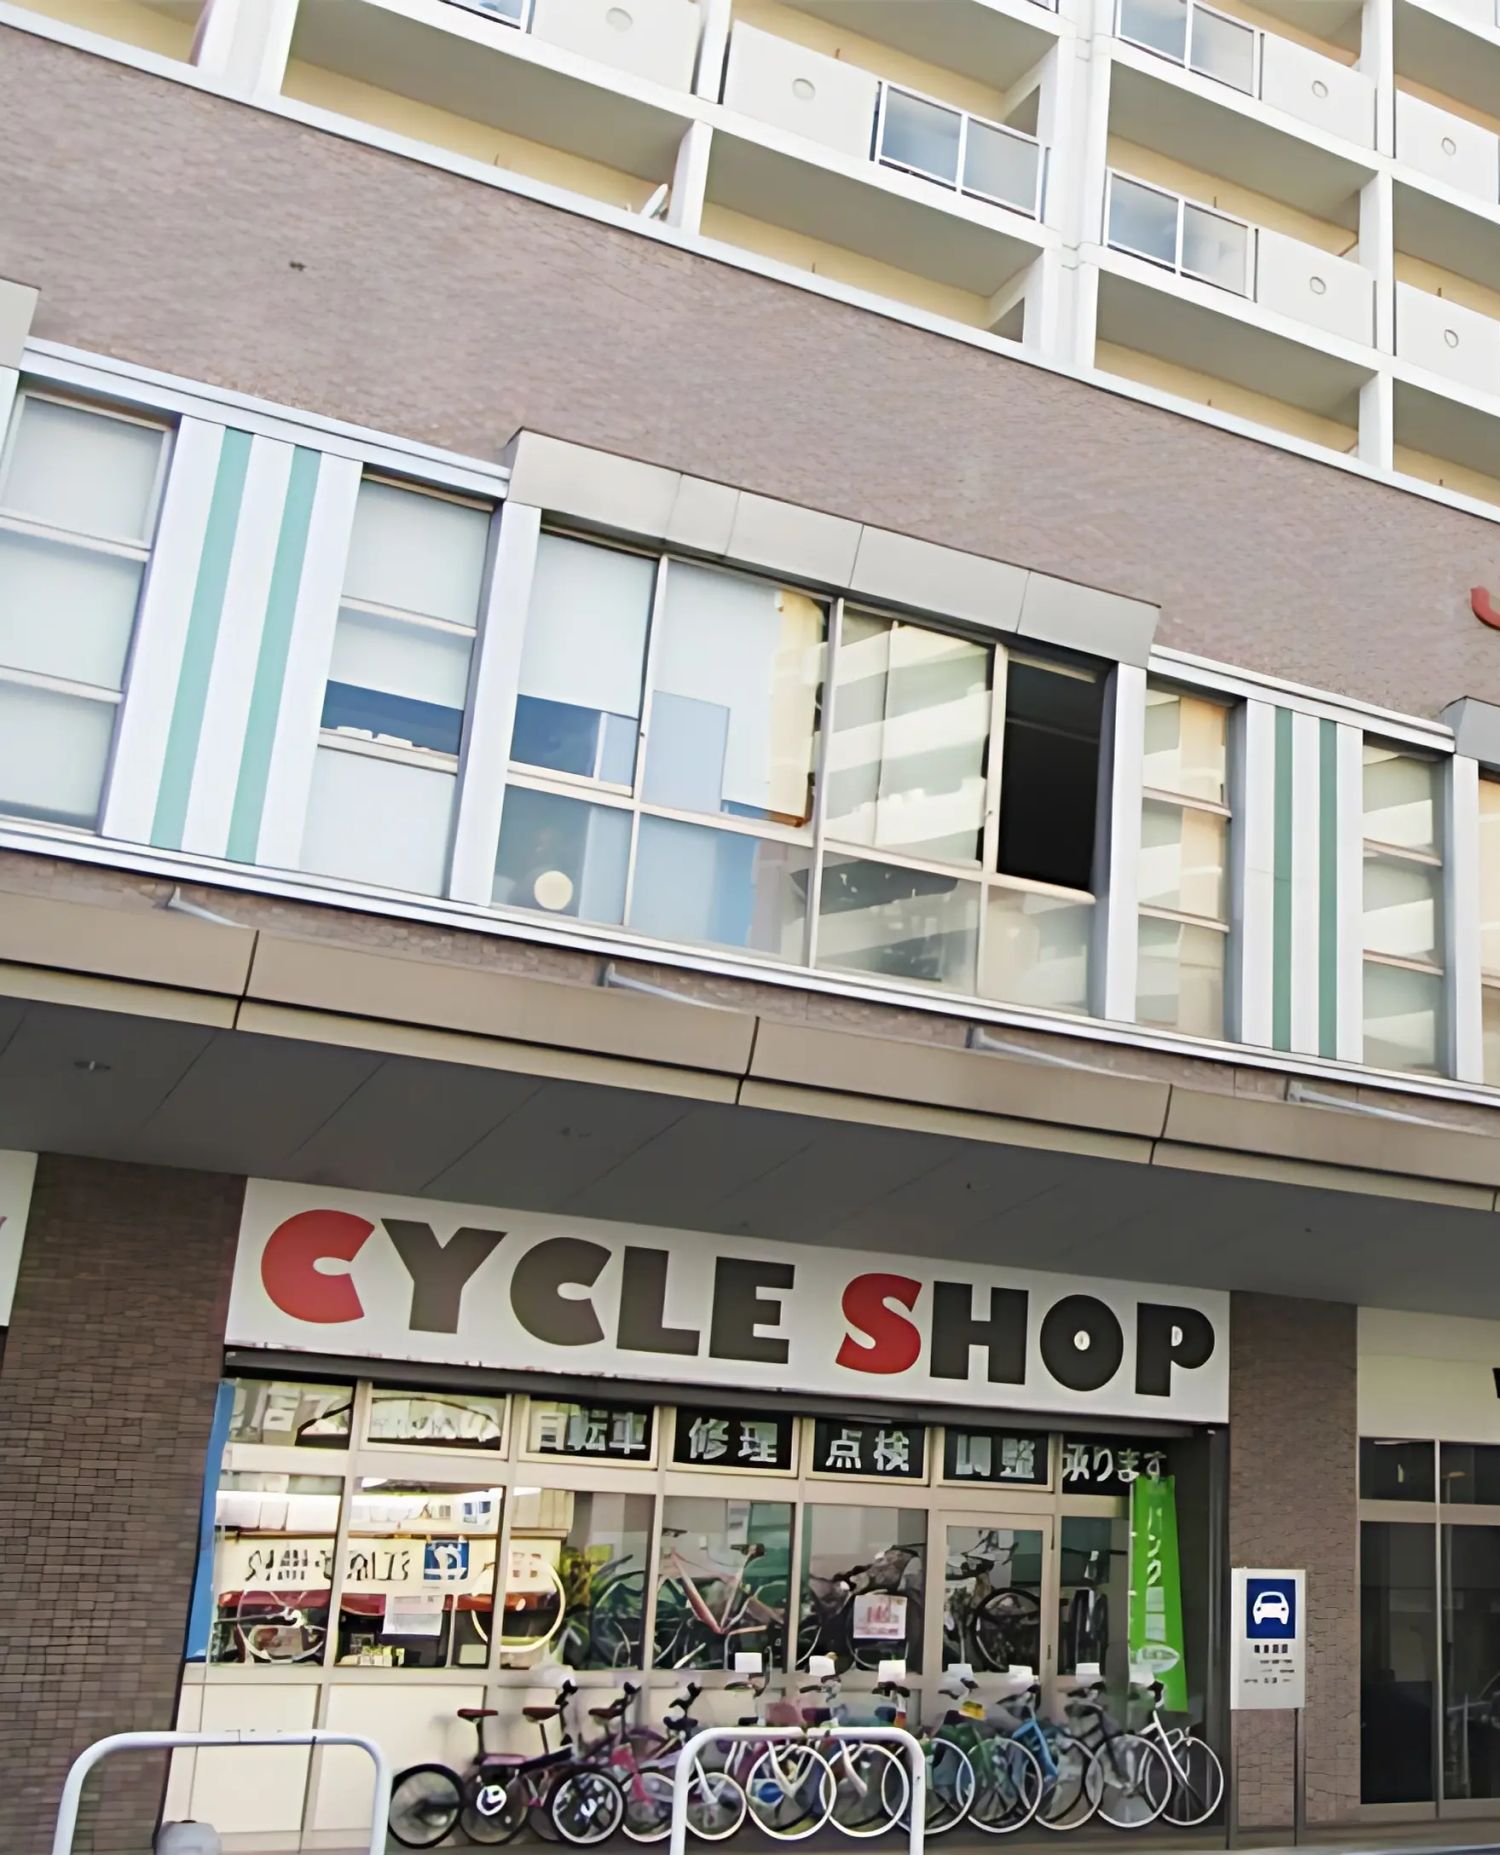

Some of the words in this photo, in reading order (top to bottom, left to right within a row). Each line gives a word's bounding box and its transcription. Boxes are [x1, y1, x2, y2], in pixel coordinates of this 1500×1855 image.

[260, 1208, 796, 1364] CYCLE
[835, 1272, 1216, 1398] SHOP
[688, 1416, 778, 1463] 修理
[824, 1428, 911, 1472] 点検
